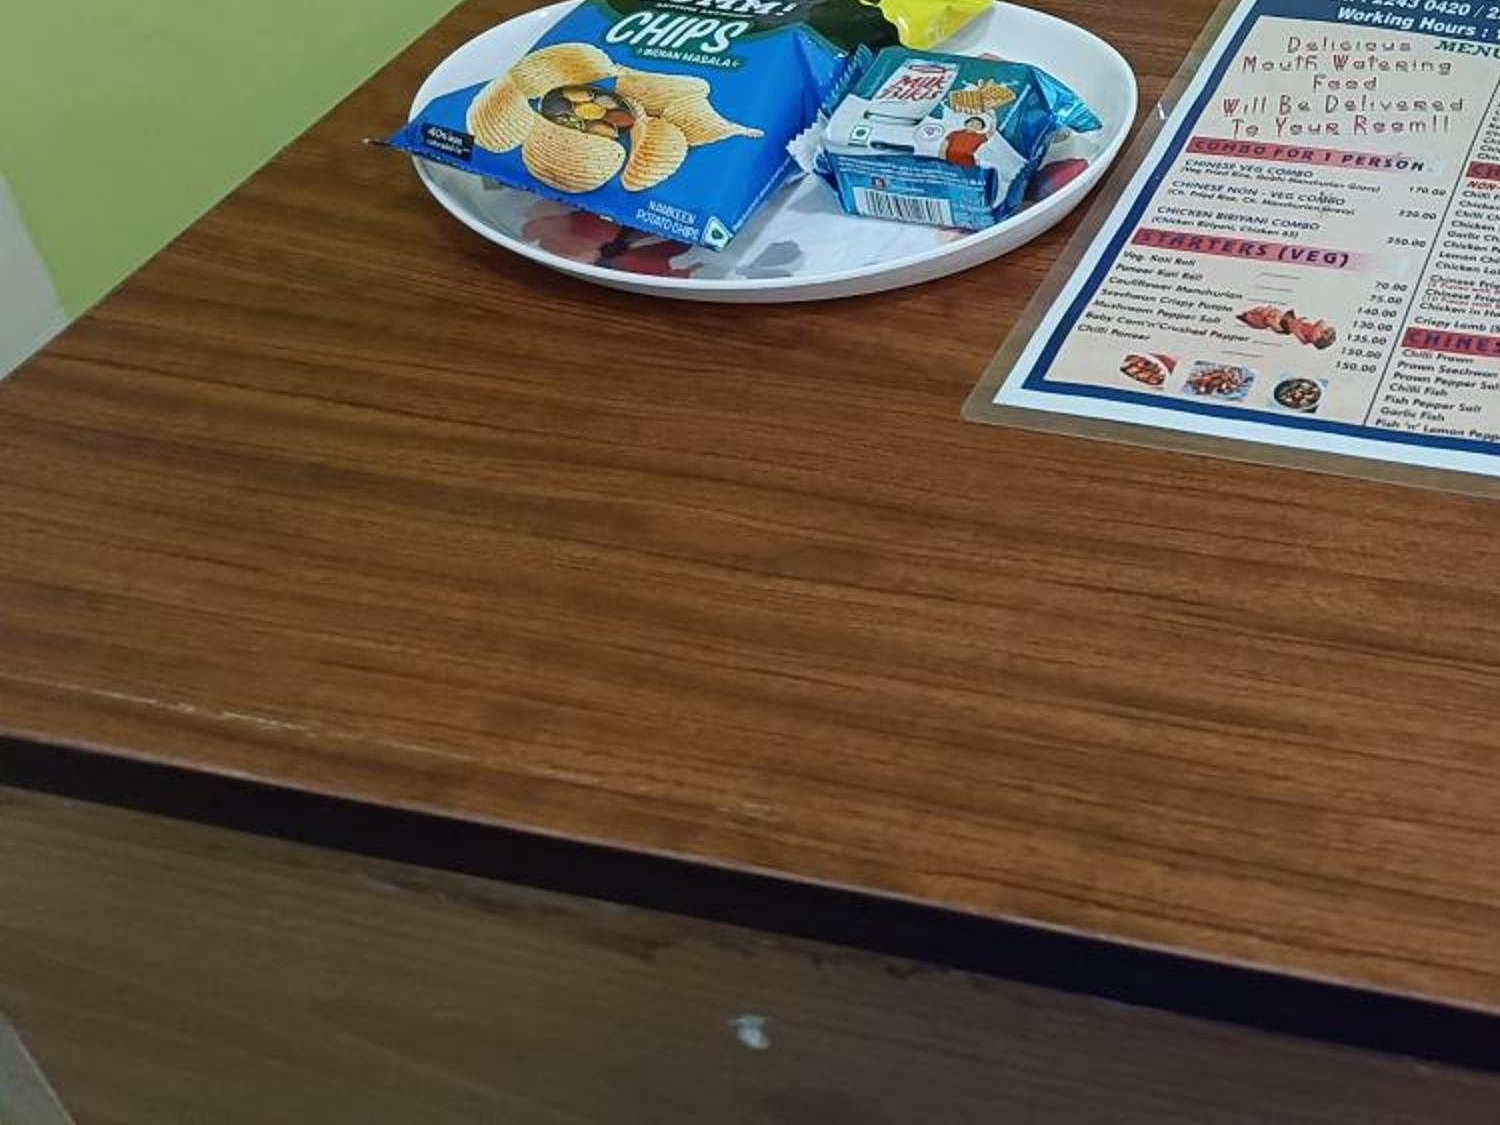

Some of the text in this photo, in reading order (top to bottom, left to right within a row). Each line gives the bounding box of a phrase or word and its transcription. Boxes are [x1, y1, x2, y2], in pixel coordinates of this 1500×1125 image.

[1423, 0, 1471, 15] 0420
[1335, 7, 1415, 28] Working
[1419, 17, 1478, 35] Hours
[606, 11, 749, 54] CHIPS
[682, 52, 731, 67] MASALA
[1313, 74, 1377, 92] Food
[1223, 96, 1267, 117] Will
[1279, 95, 1310, 115] Be
[1231, 119, 1259, 138] To
[1342, 153, 1424, 173] PERSON
[1156, 205, 1213, 219] CHICKEN
[1451, 220, 1495, 230] Chicken
[1443, 240, 1488, 251] Chicken
[1277, 247, 1349, 266] (VEG)
[1440, 251, 1477, 261] Lemon
[1435, 261, 1480, 272] Chicken
[1431, 274, 1475, 286] Chinese
[1176, 283, 1243, 298] Manchurian
[1357, 306, 1397, 317] 140.00
[1425, 287, 1470, 299] Chinese
[1420, 301, 1466, 313] Chicken
[1155, 308, 1196, 321] Pepper
[1414, 315, 1450, 328] Crispy
[1084, 311, 1114, 323] Baby
[1209, 329, 1251, 343] Pepper
[1402, 348, 1433, 359] Chilli
[1336, 360, 1376, 373] 150.00
[1397, 359, 1434, 371] Prawn
[1393, 371, 1430, 383] Prawn
[1435, 376, 1477, 389] Pepper
[1389, 382, 1420, 394] Chilli
[1425, 386, 1448, 396] Fish
[1384, 394, 1410, 404] Fish
[1413, 397, 1455, 411] Pepper
[1379, 406, 1417, 418] Garlic
[1421, 411, 1445, 421] Fish
[1423, 424, 1464, 436] Lemon
